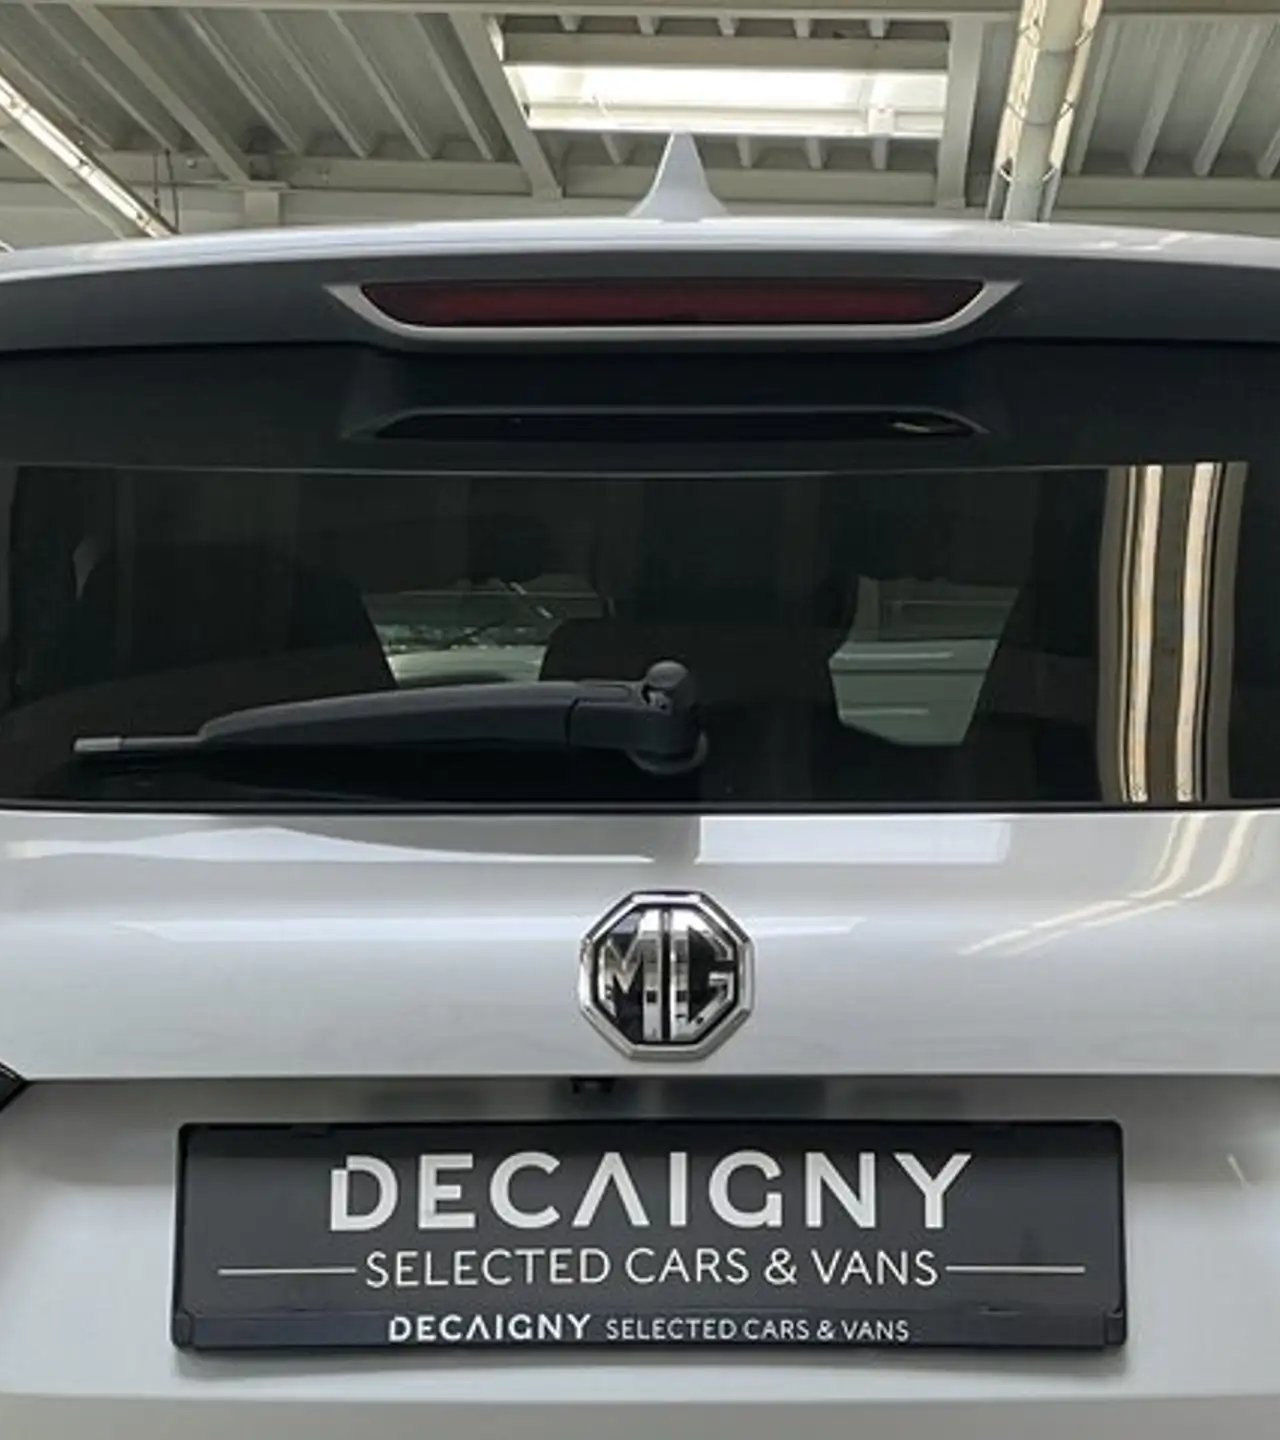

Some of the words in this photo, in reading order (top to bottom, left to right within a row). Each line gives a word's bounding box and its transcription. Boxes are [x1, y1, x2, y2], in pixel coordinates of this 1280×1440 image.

[595, 906, 736, 1043] MG
[331, 1151, 972, 1232] DECAIGNY
[365, 1247, 611, 1289] SELECTED
[624, 1247, 751, 1287] CARS
[763, 1247, 798, 1288] &
[810, 1247, 938, 1288] VANS
[388, 1313, 592, 1343] DECAIGNY
[605, 1316, 737, 1342] SELECTED
[741, 1317, 810, 1342] CARS
[816, 1318, 836, 1342] &
[839, 1318, 910, 1343] VANS
